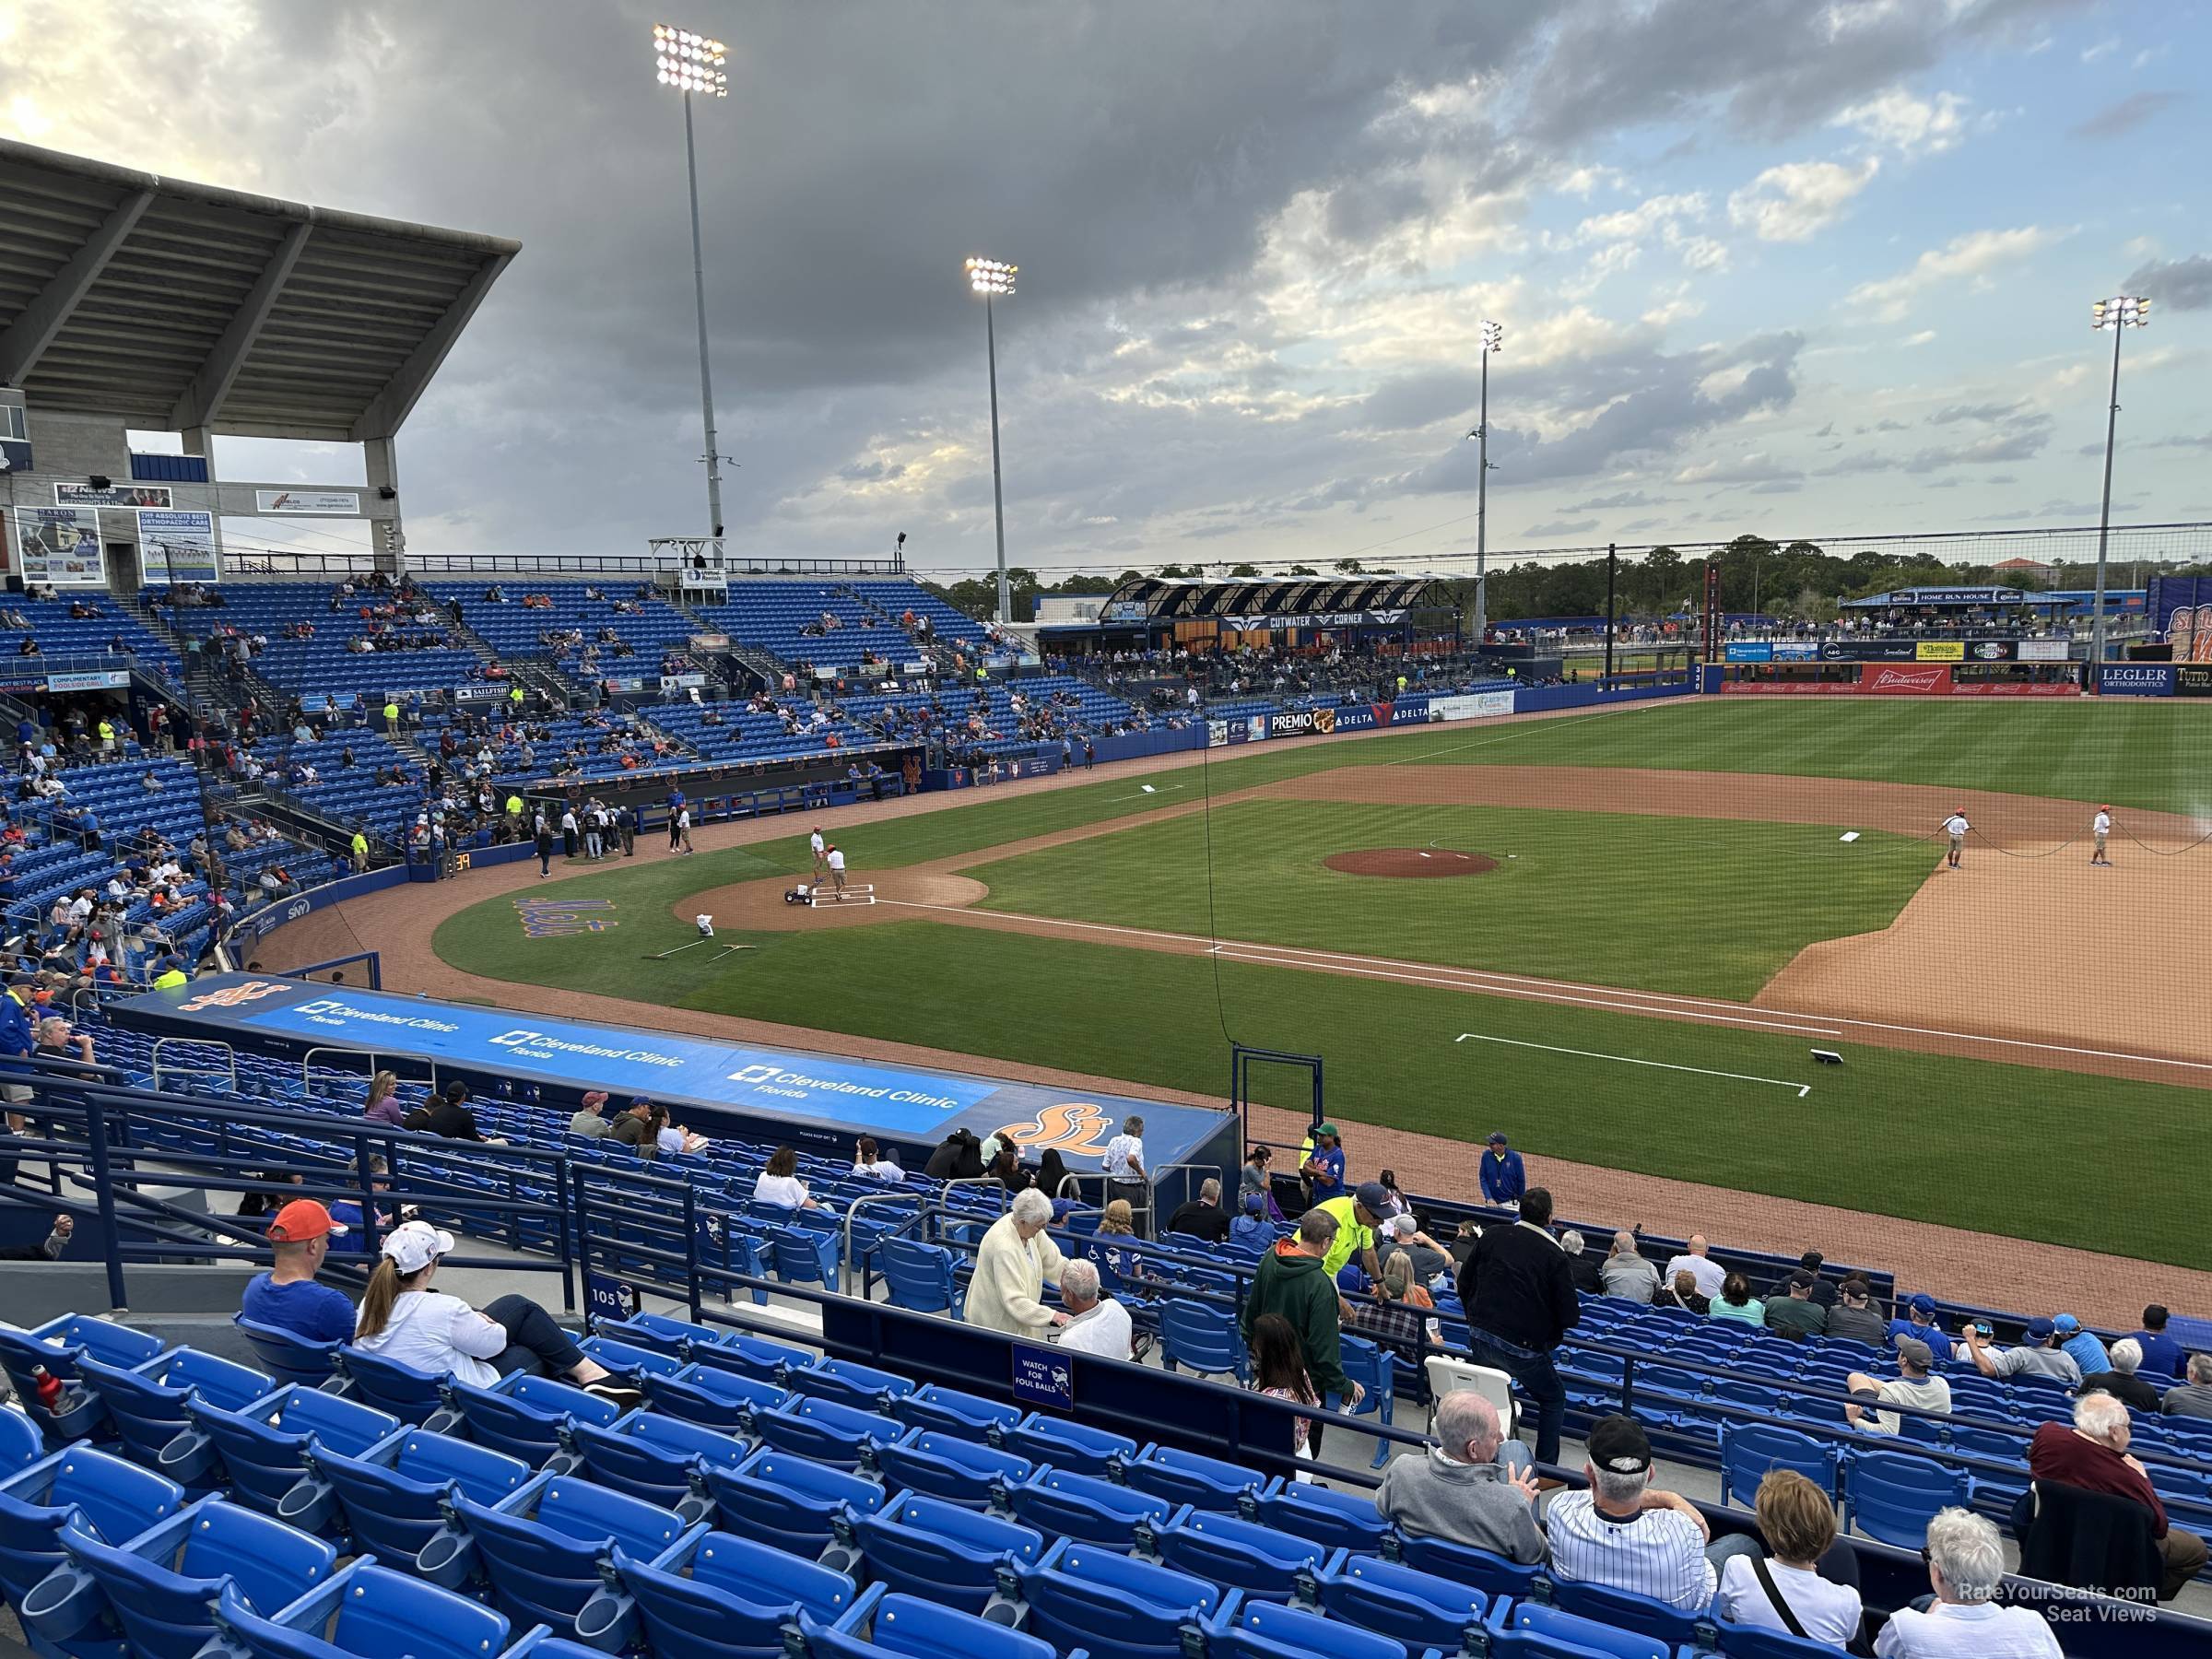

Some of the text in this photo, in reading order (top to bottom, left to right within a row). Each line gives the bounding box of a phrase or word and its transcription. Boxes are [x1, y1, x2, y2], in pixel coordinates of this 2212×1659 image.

[1270, 614, 1363, 629] CUTWATER CORNER
[53, 676, 101, 684] COMPLIMENTARY
[1879, 674, 1936, 684] Budweiser
[2102, 669, 2168, 680] LEGLER
[1344, 713, 1372, 724] DELTA
[1401, 709, 1429, 719] DELTA
[1272, 713, 1312, 730] PREMIO
[288, 902, 307, 920] SNY
[305, 1015, 347, 1026] Florida
[334, 1006, 460, 1033] Cleveland Clinic
[505, 1046, 555, 1060] Florida
[529, 1037, 686, 1067] Cleveland Clinic
[753, 1084, 809, 1100] Florida
[775, 1072, 959, 1110] Cleveland Clinic
[593, 1288, 616, 1306] 105
[1022, 1359, 1048, 1371] WATCH
[1028, 1371, 1042, 1381] FOR
[1015, 1377, 1056, 1394] FOUL BALLS
